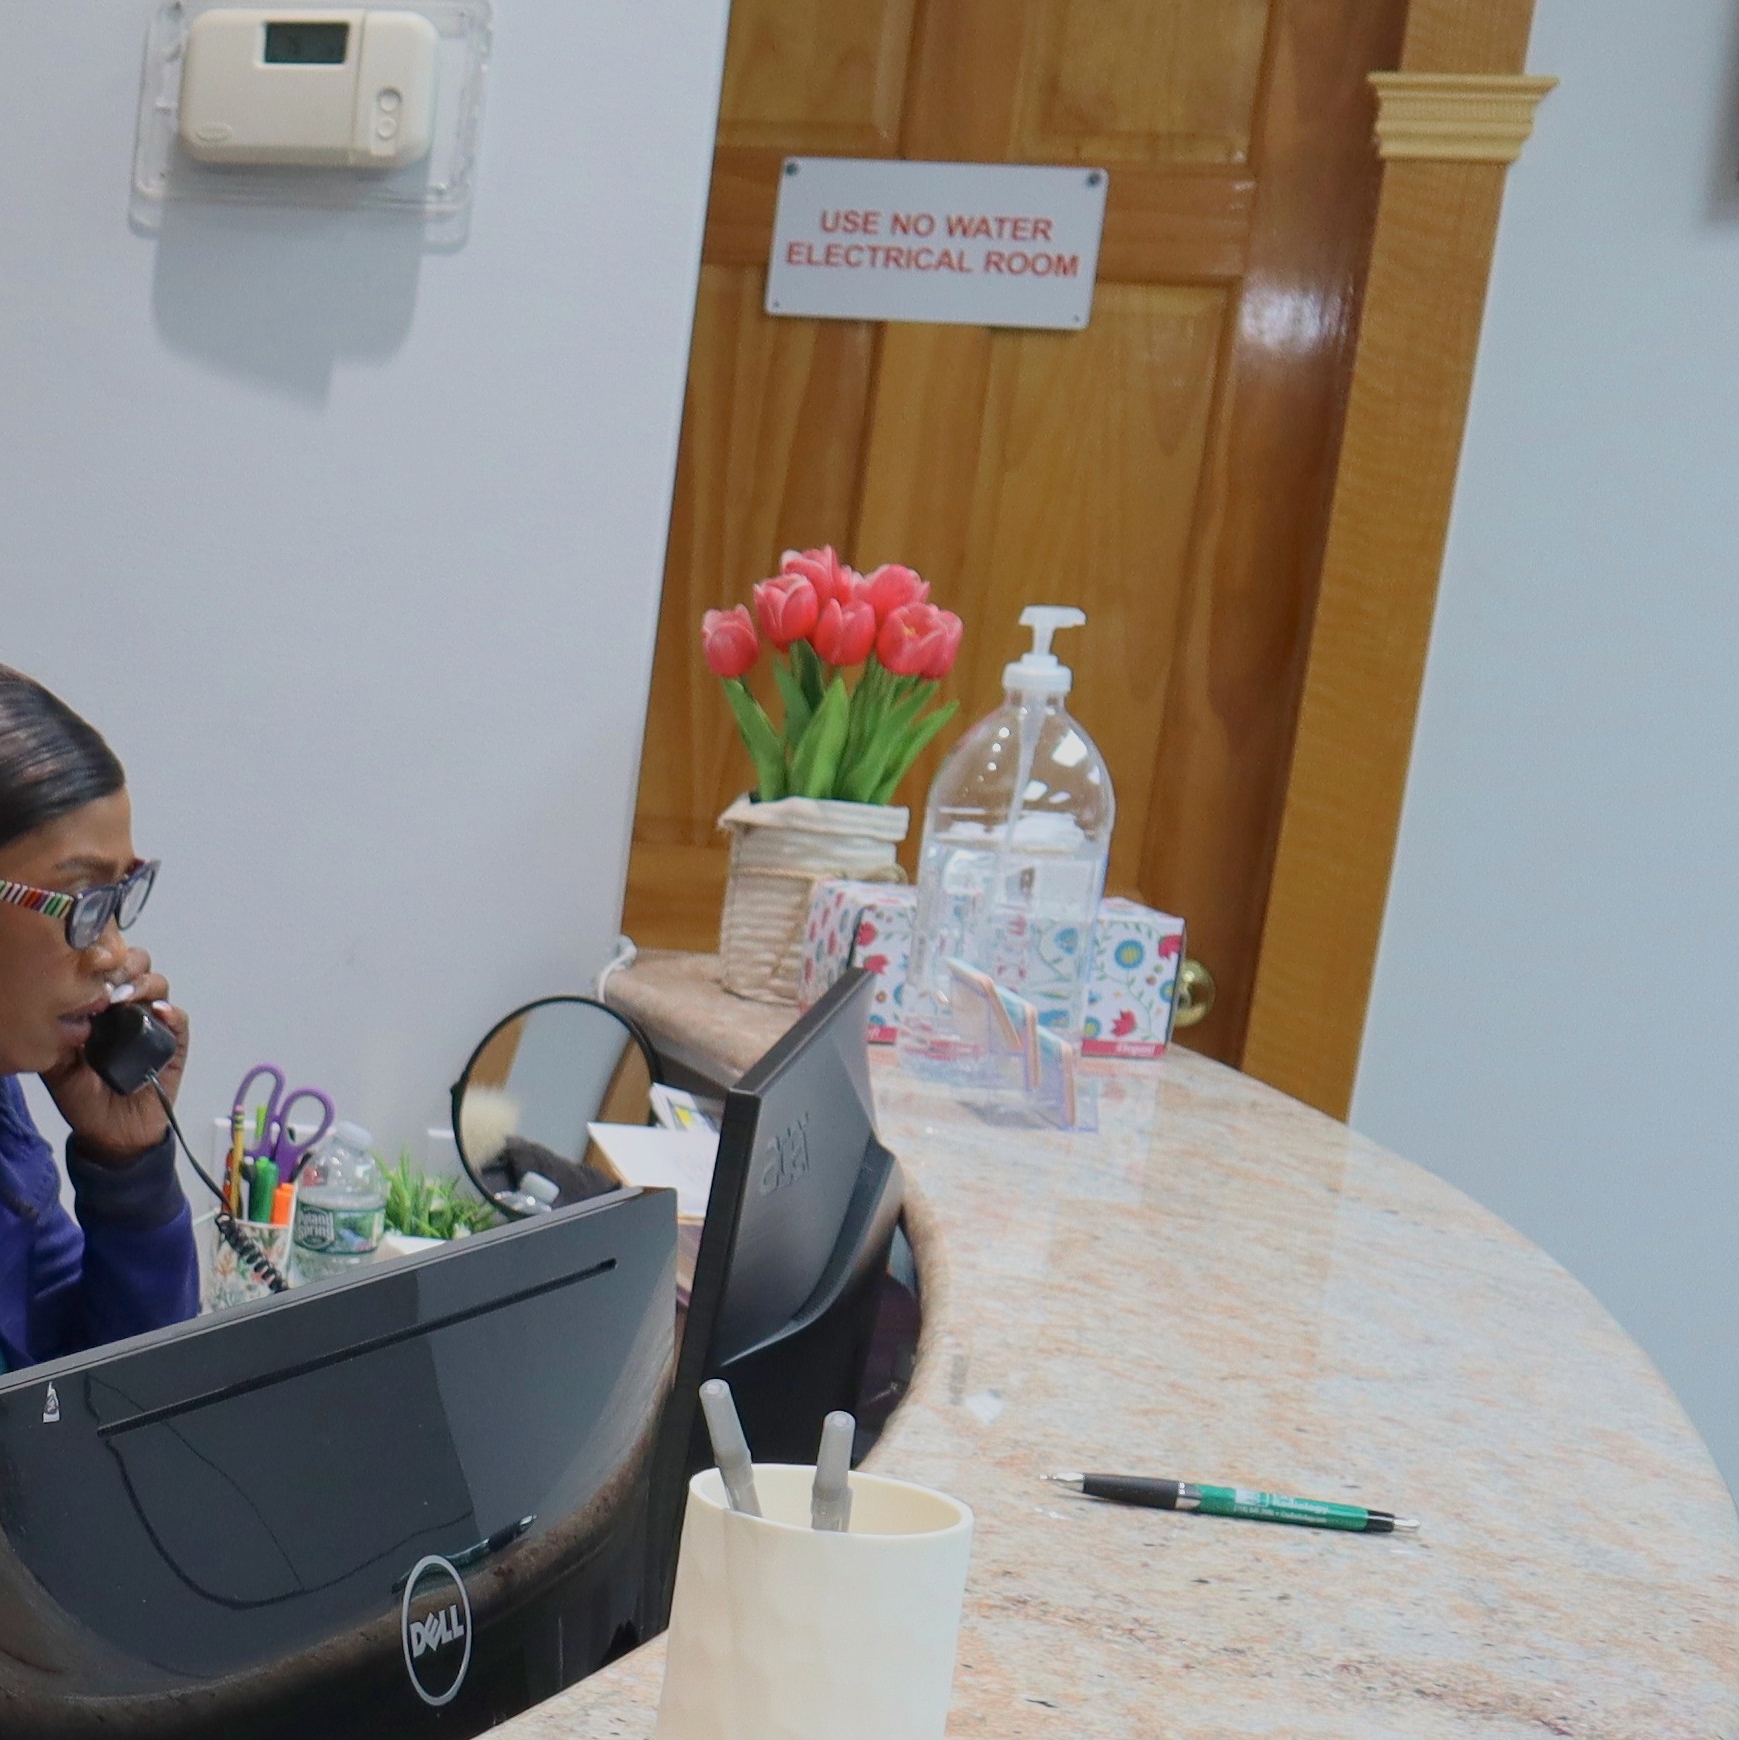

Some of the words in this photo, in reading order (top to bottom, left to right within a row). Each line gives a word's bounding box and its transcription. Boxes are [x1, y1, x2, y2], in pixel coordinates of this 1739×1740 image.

[821, 210, 880, 235] USE
[891, 212, 936, 237] NO
[946, 215, 1054, 241] WATER
[786, 241, 973, 273] ELECTRICAL
[984, 251, 1081, 277] ROOM
[409, 1604, 465, 1658] DELL
